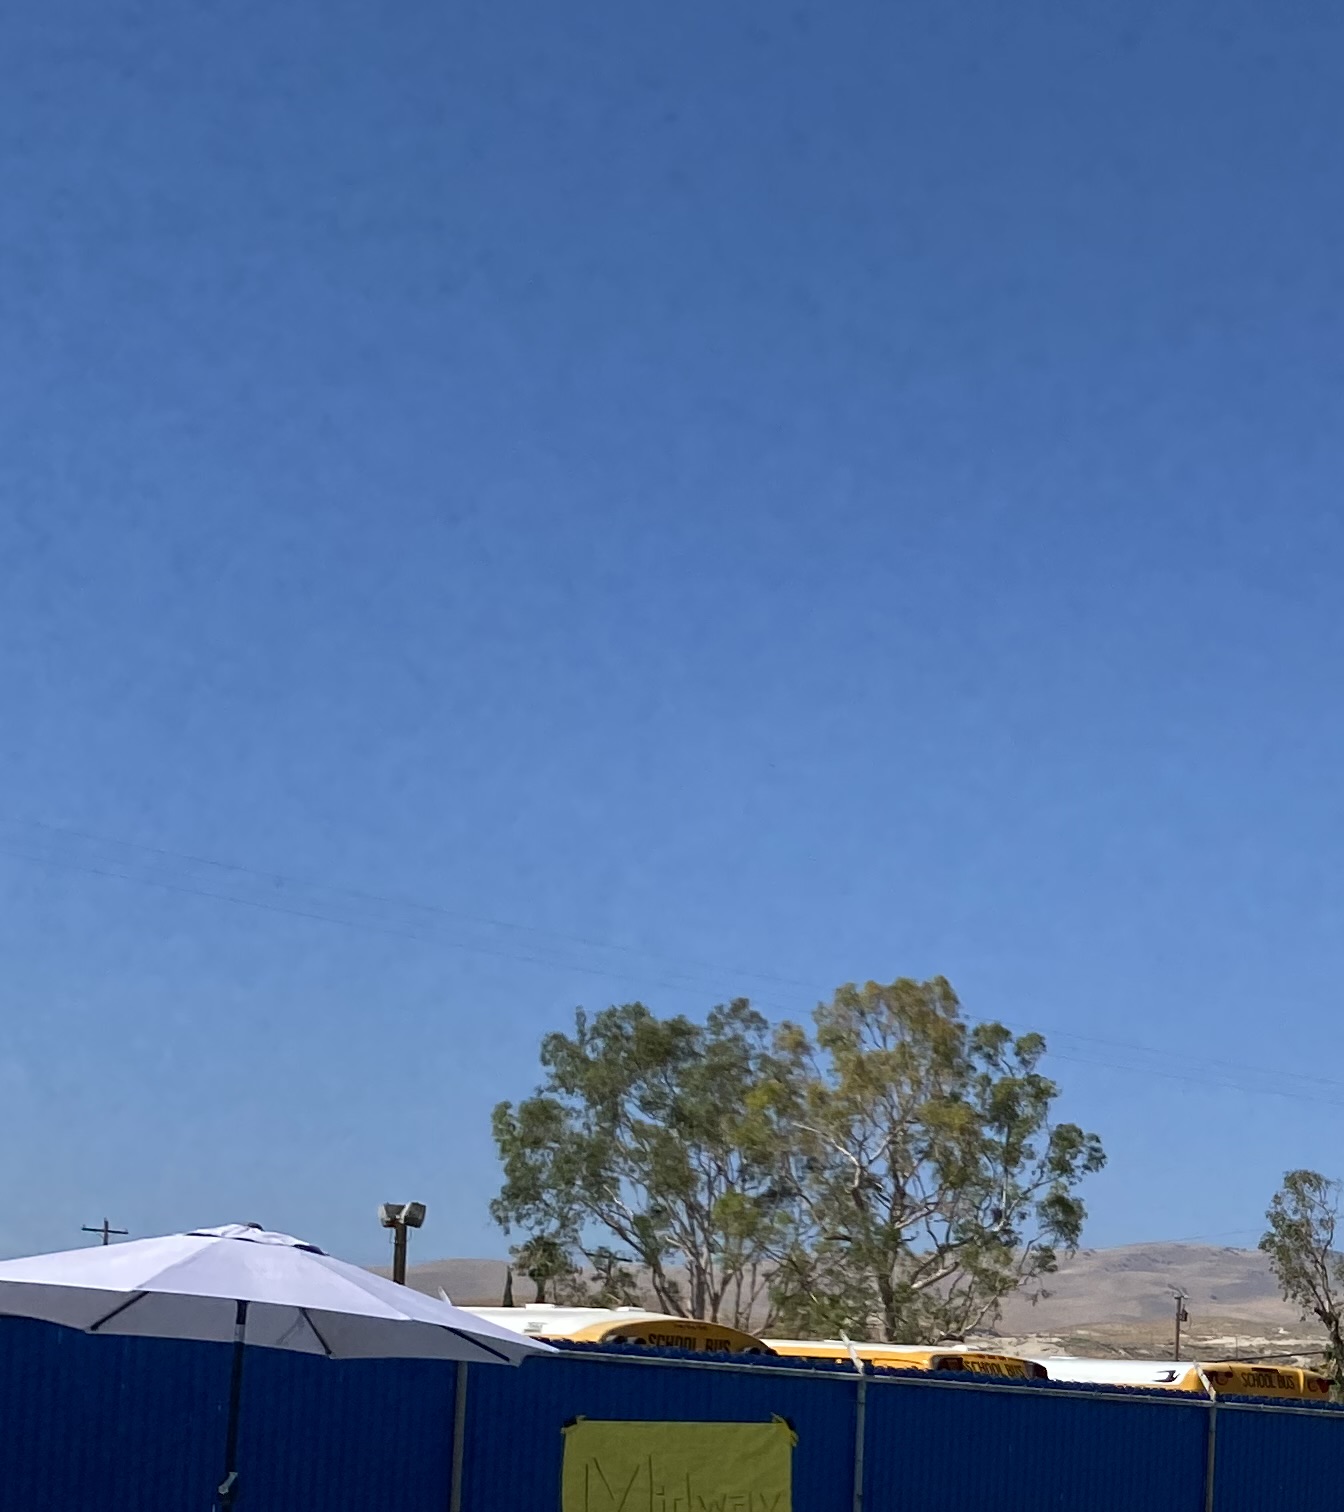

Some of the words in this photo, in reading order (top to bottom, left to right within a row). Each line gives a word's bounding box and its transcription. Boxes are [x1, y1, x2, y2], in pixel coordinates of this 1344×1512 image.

[648, 1333, 698, 1350] SCHOOL
[705, 1338, 731, 1354] BUS
[1241, 1372, 1276, 1388] SCHOOL
[1278, 1374, 1295, 1390] BUS
